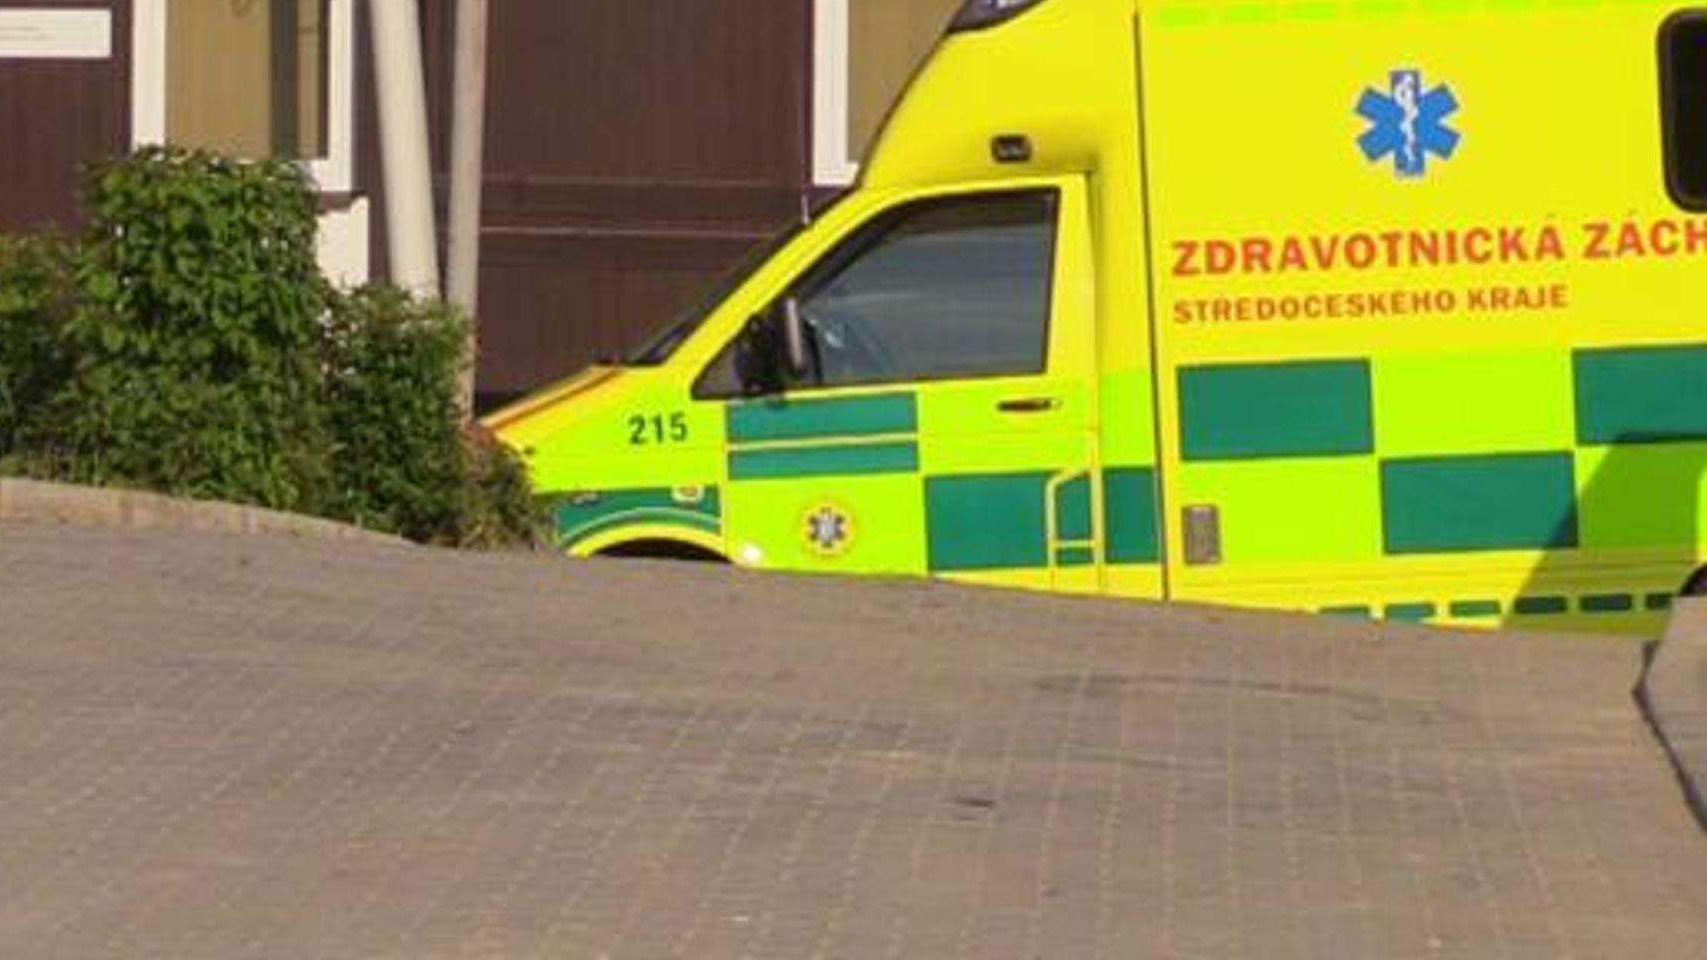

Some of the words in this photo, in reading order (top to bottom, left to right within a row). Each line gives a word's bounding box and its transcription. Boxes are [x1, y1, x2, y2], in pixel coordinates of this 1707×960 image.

[1172, 212, 1565, 277] ZDRAVOTNICKÁ
[1467, 283, 1568, 312] KRAJE
[628, 410, 688, 444] 215
